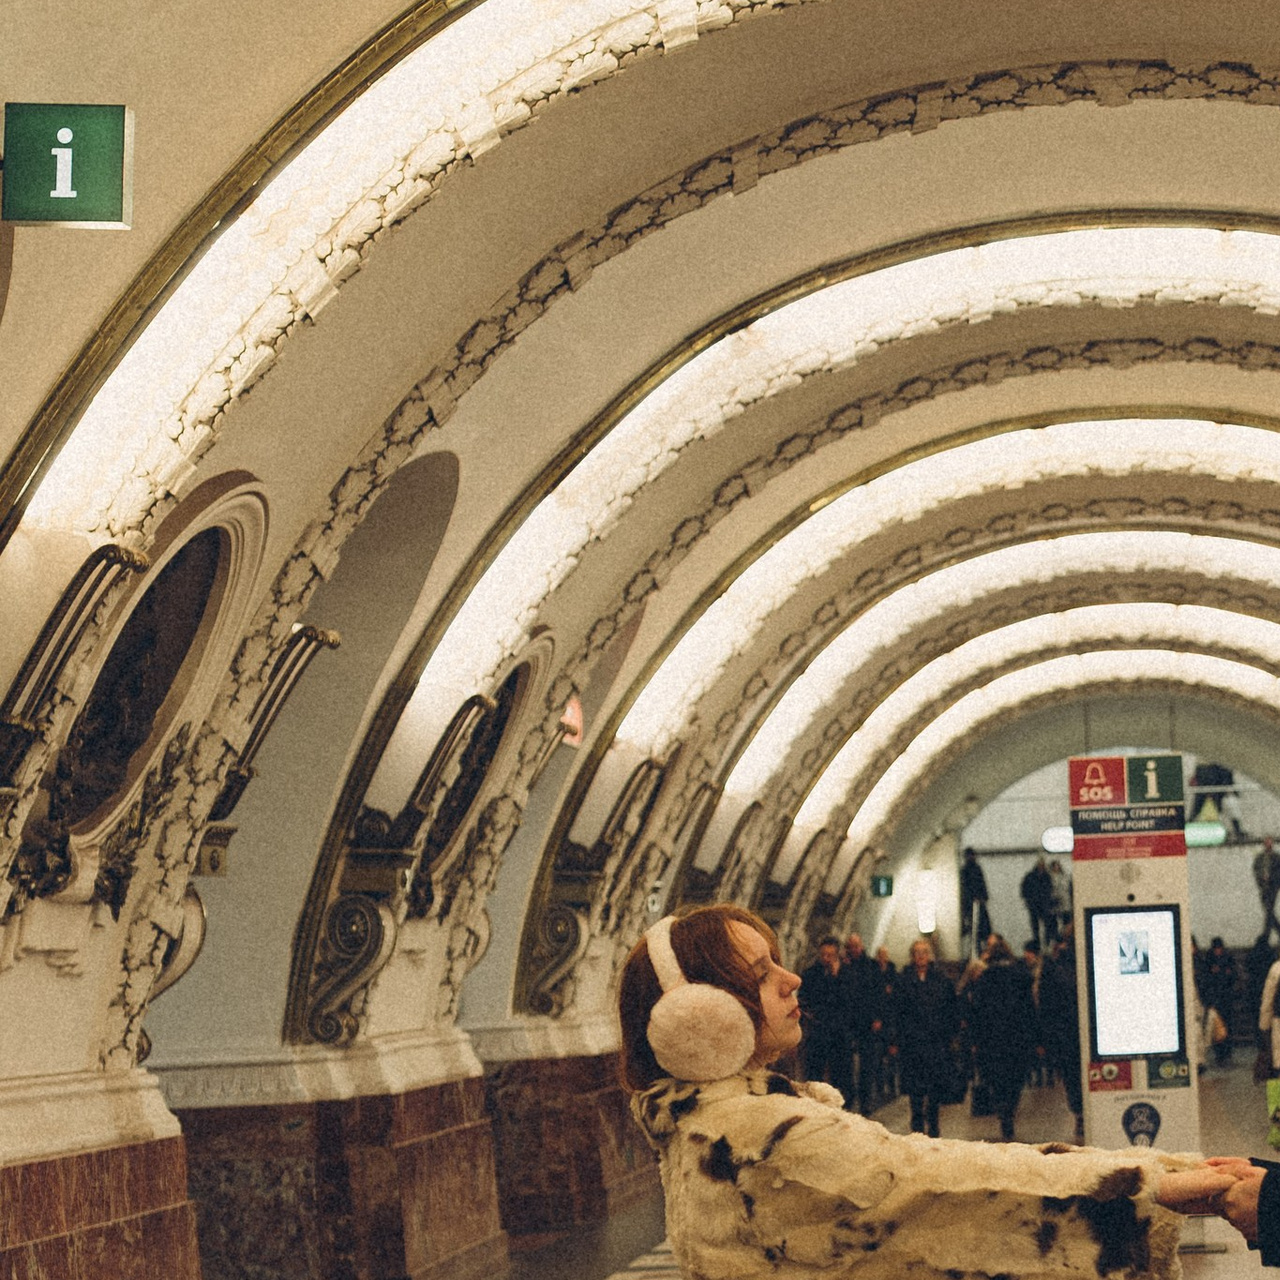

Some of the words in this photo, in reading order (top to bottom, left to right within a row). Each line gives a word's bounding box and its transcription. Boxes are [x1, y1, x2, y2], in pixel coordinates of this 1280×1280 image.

[50, 127, 77, 198] i
[1143, 759, 1161, 799] i
[1078, 785, 1114, 802] SOS
[1078, 809, 1126, 820] ПОМОЩЬ
[1129, 807, 1176, 818] СПРАВКА
[1100, 821, 1124, 831] HELP
[1125, 819, 1155, 829] POINT
